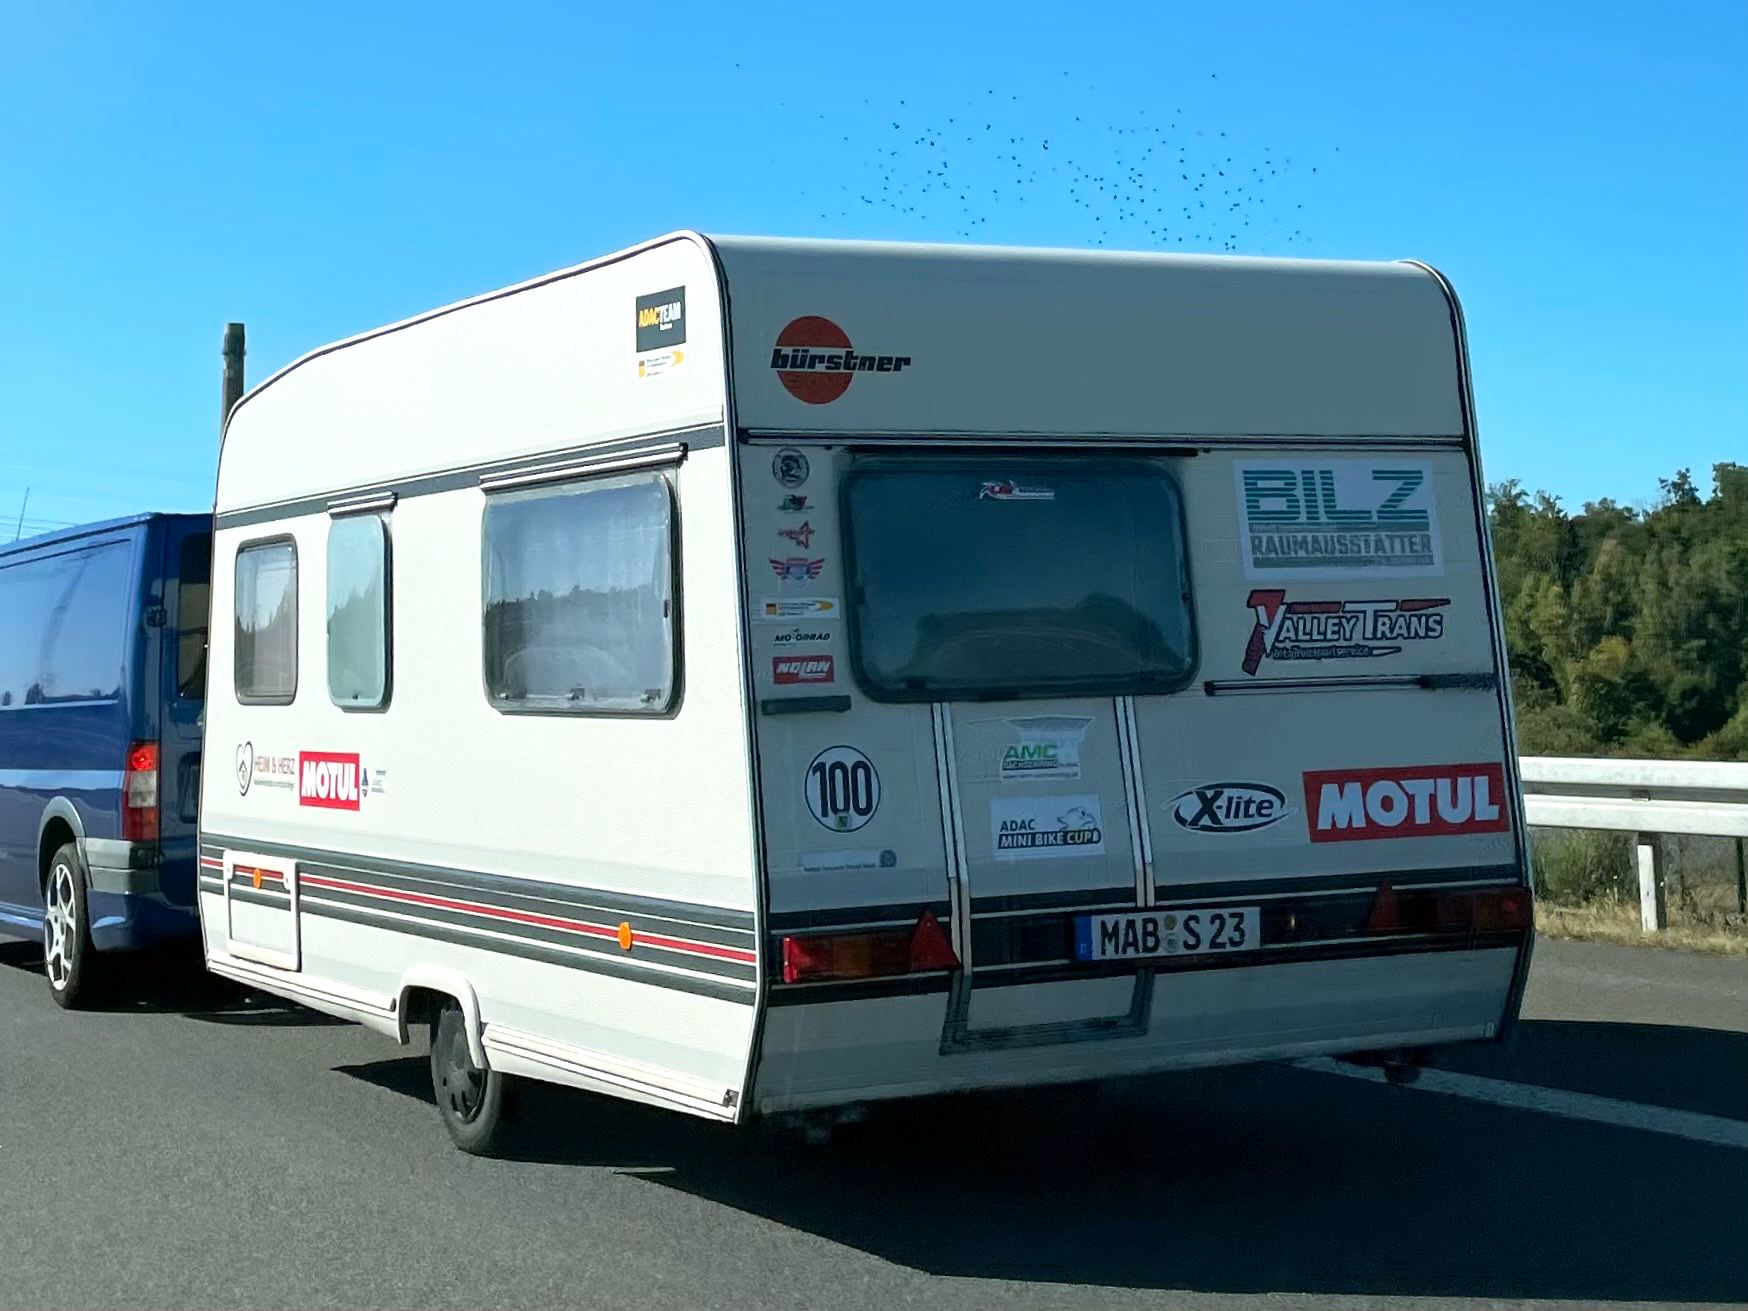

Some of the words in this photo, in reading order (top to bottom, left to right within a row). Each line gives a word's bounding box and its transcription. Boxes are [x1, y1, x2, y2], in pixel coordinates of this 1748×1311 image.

[770, 348, 911, 372] bürstner
[1243, 470, 1428, 520] BILZ
[1255, 604, 1359, 654] VALLEY
[1342, 601, 1444, 640] TRANS
[776, 661, 831, 678] NOLAN
[1004, 744, 1058, 760] AMC
[302, 760, 358, 800] MOTUL
[812, 760, 873, 817] 100
[1187, 790, 1273, 826] X-lite
[1316, 776, 1500, 830] MOTUL
[1000, 819, 1035, 832] ADAC
[1000, 834, 1032, 848] MINI
[1035, 832, 1065, 846] BIKE
[1067, 831, 1092, 844] CUP
[1100, 917, 1160, 956] MAB
[1183, 914, 1201, 950] S
[1209, 912, 1245, 950] 23
